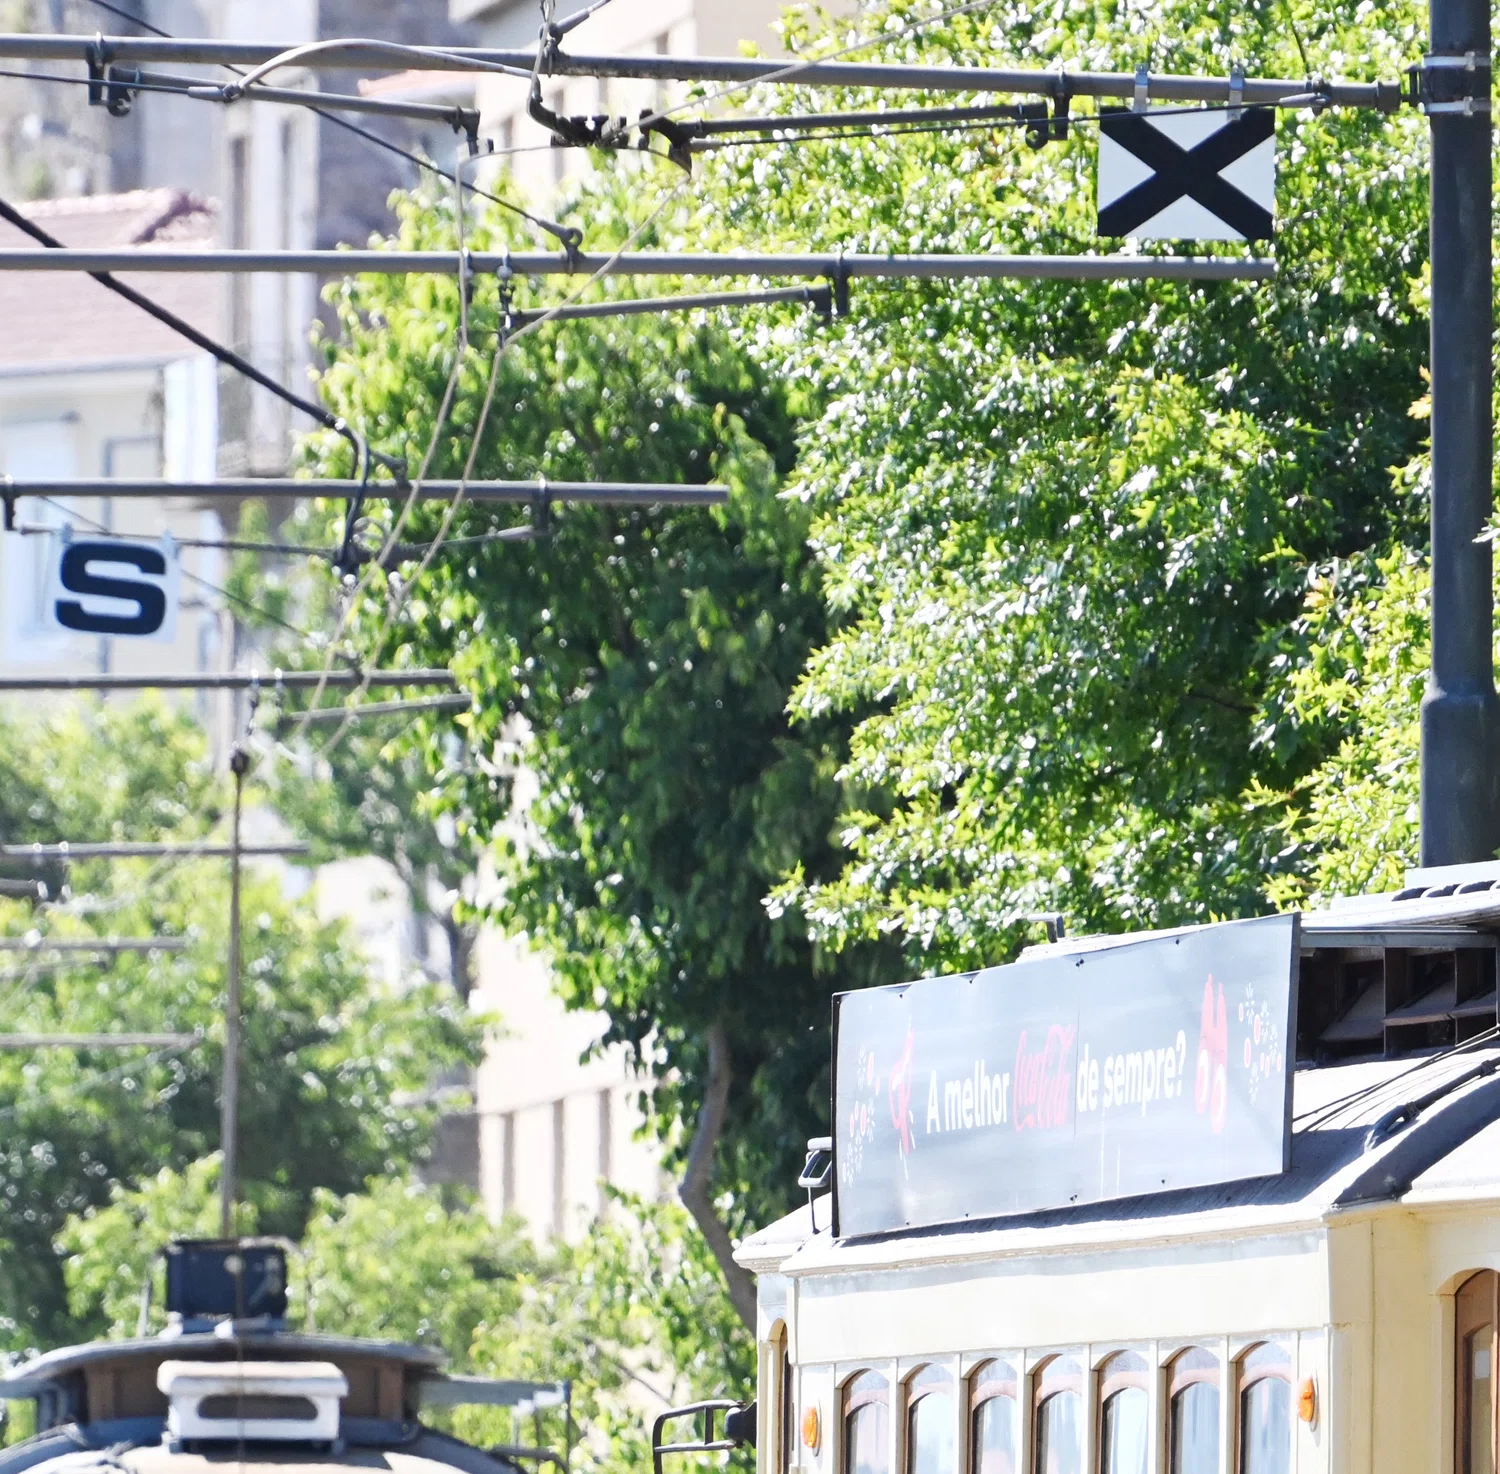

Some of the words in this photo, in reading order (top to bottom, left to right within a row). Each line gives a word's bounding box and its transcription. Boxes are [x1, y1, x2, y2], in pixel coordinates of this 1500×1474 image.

[56, 541, 166, 635] S
[927, 1069, 940, 1134] A
[944, 1059, 1010, 1131] melhor
[1077, 1043, 1099, 1112] de
[1103, 1029, 1187, 1117] sempre?
